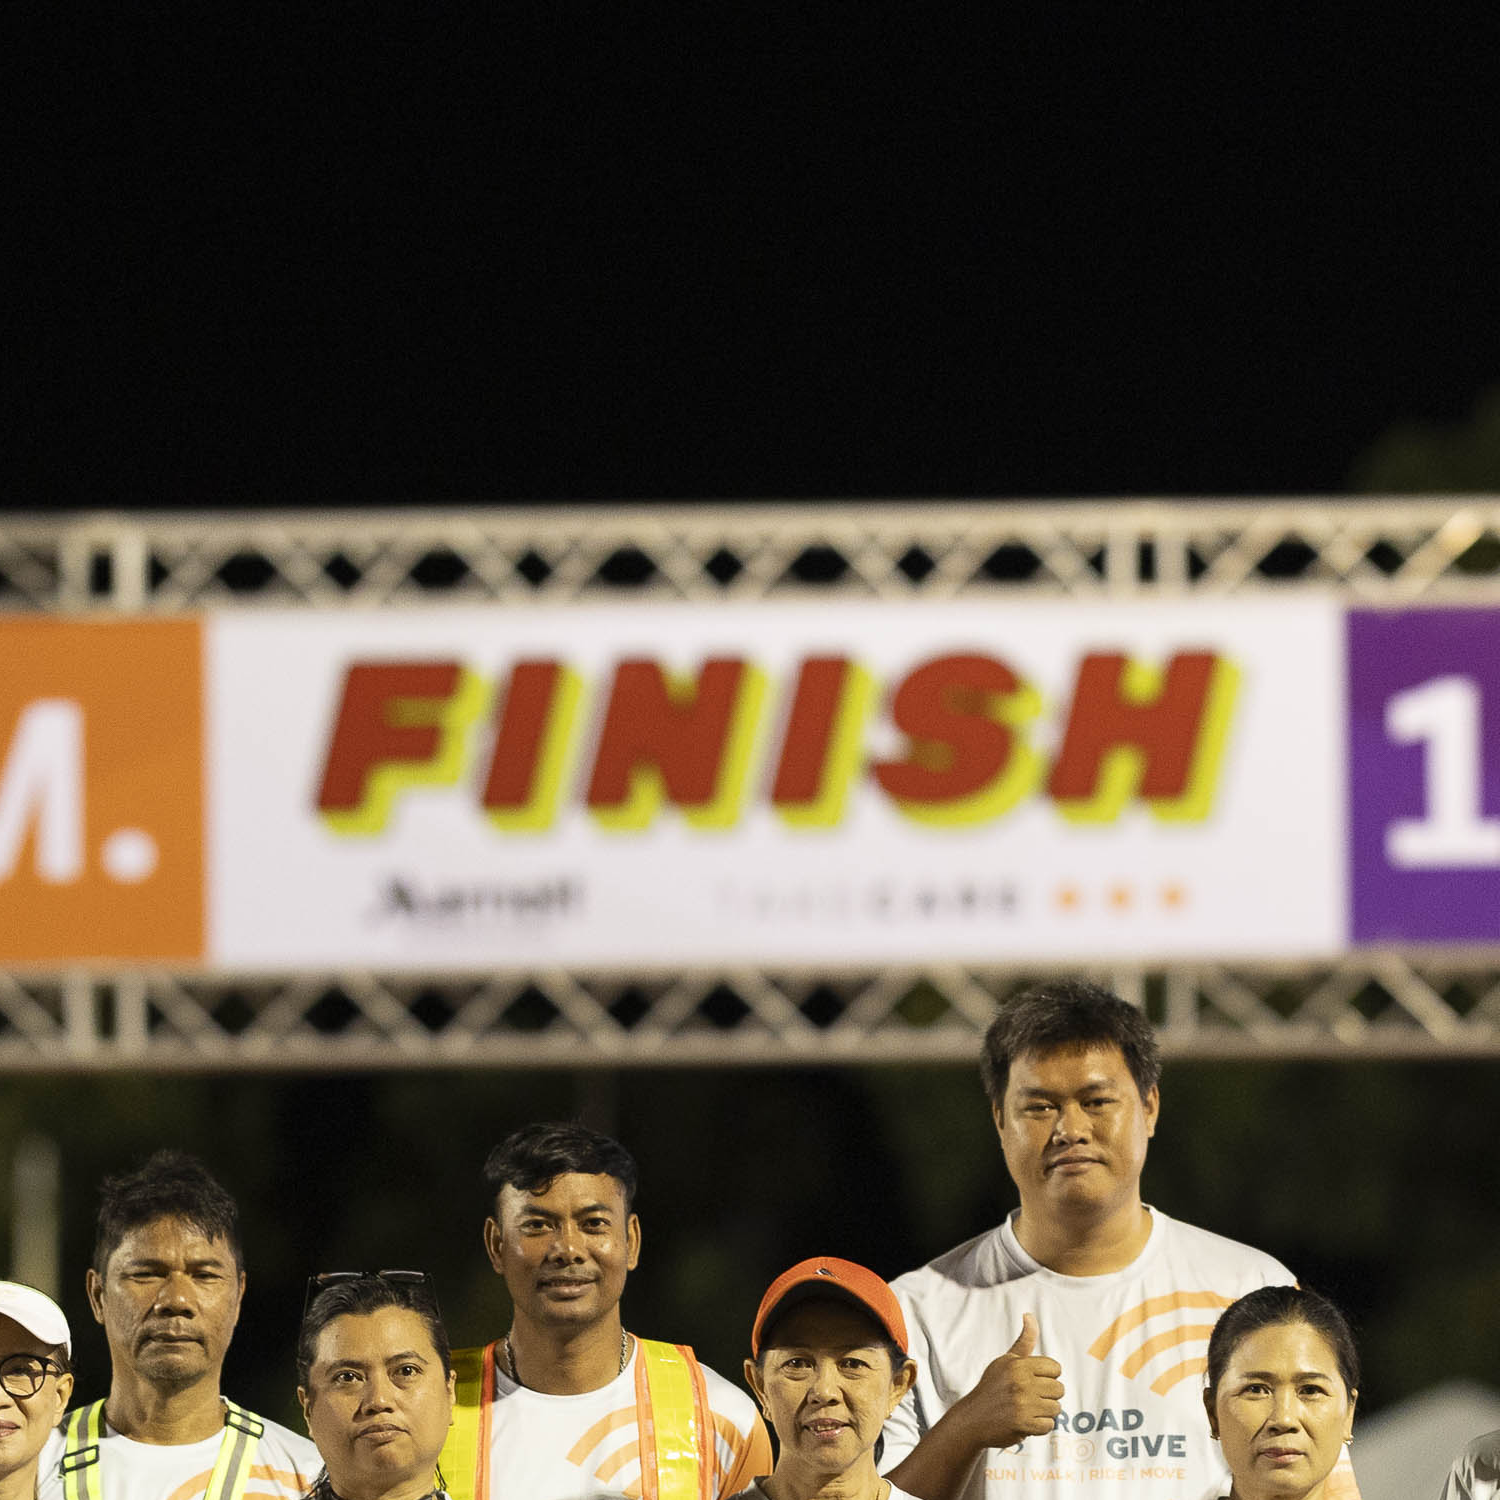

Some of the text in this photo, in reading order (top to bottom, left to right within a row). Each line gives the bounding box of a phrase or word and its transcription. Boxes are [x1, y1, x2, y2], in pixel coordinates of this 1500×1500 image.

[314, 652, 1242, 834] FINISH
[1054, 1408, 1144, 1434] ROAD
[1106, 1434, 1186, 1459] GIVE
[985, 1466, 1017, 1480] RUN
[1089, 1468, 1126, 1481] RIDE
[1140, 1466, 1186, 1480] MOVE
